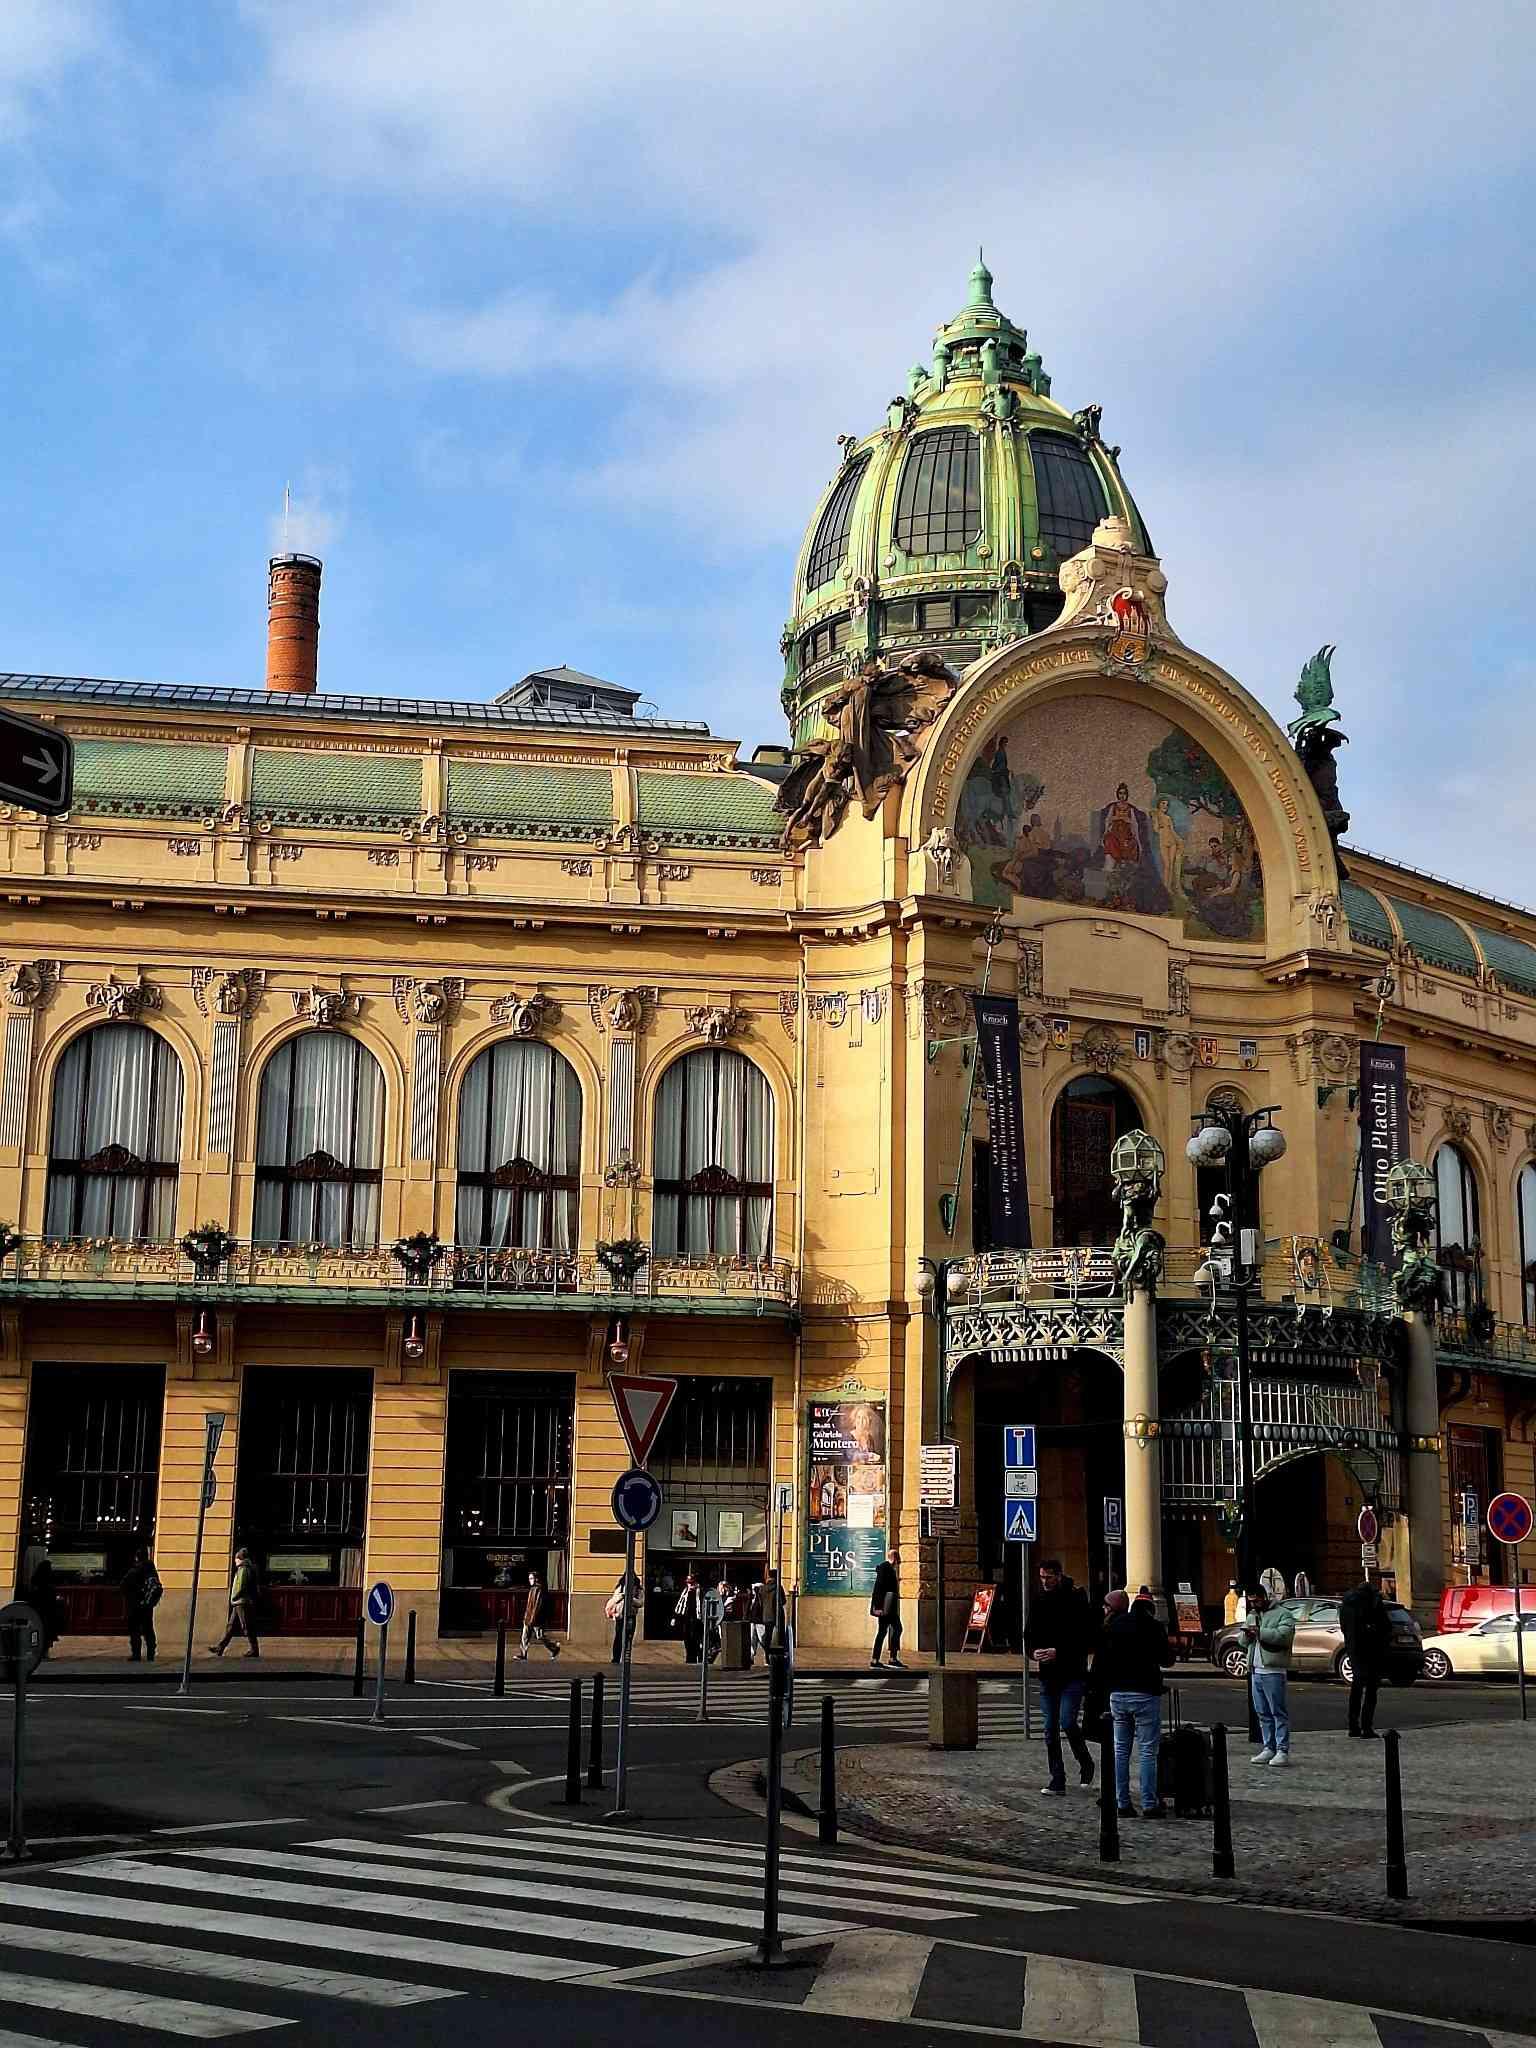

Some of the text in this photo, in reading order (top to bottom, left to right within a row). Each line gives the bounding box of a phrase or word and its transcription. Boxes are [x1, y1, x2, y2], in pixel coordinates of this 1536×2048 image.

[1370, 1082, 1388, 1150] Placht
[813, 1438, 859, 1449] Montero
[809, 1534, 840, 1553] PL
[829, 1551, 857, 1570] ES
